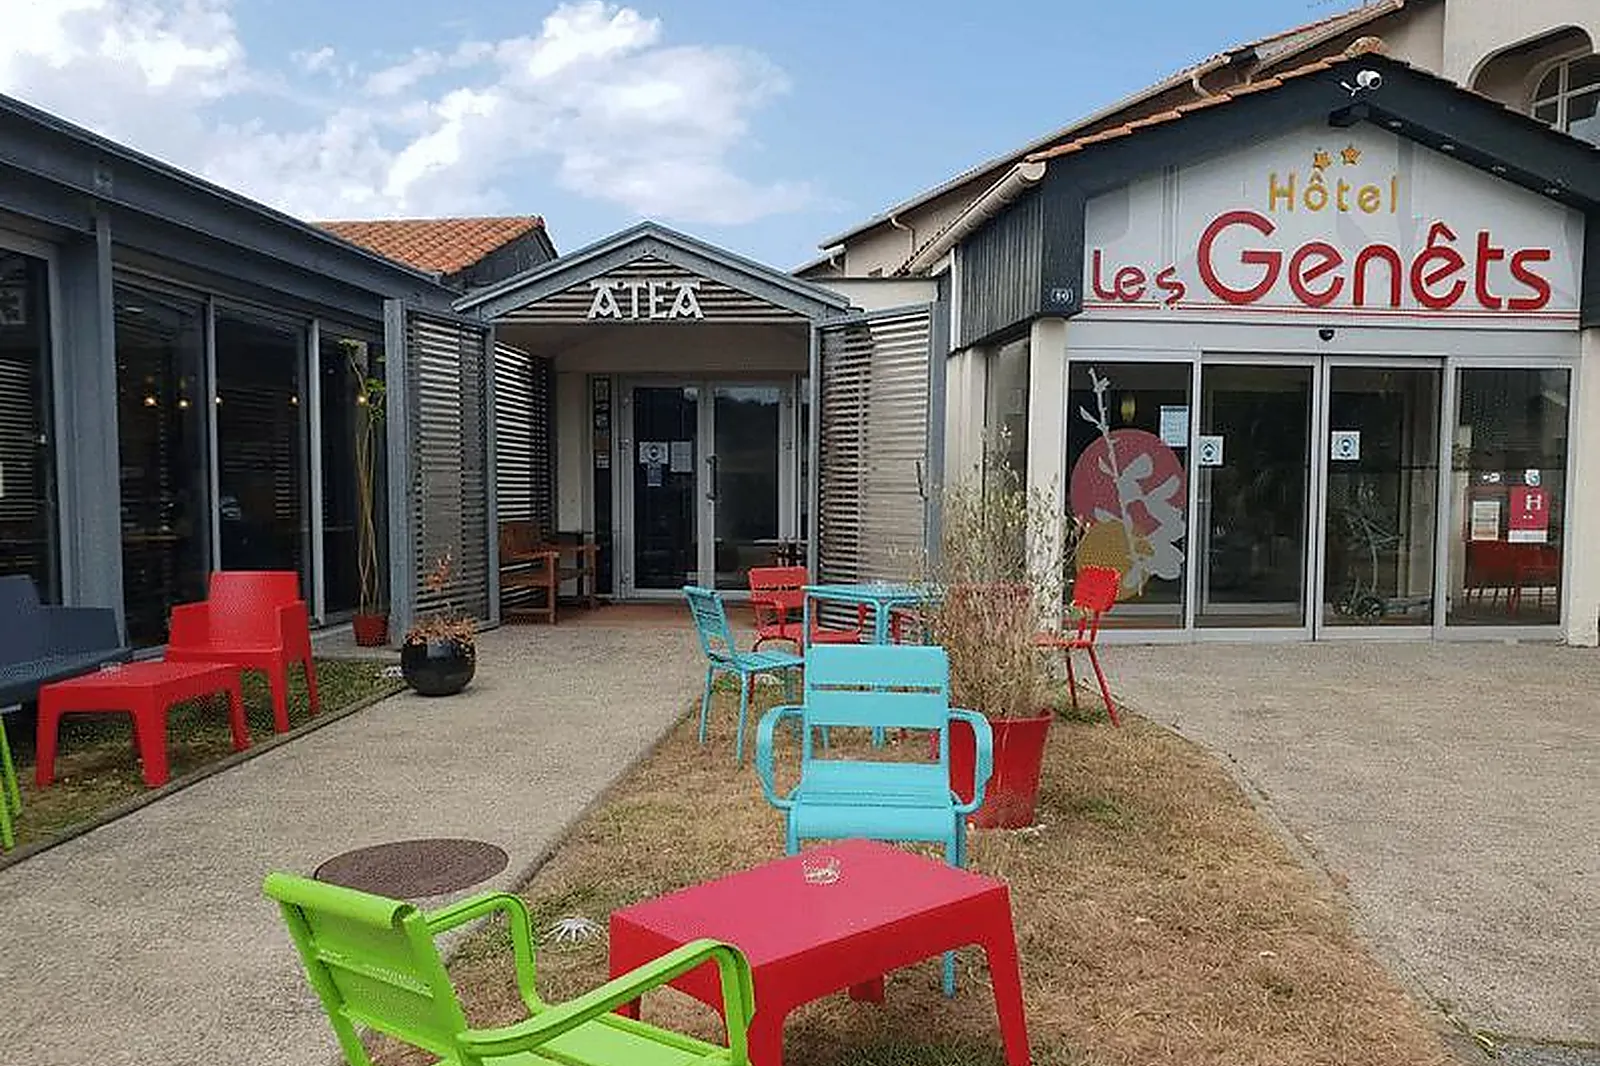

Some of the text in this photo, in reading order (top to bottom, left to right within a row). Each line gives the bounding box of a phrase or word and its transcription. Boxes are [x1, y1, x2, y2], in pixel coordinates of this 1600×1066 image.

[1268, 170, 1397, 214] Hôtel
[1197, 210, 1551, 310] Genêts
[587, 279, 704, 319] ATEA
